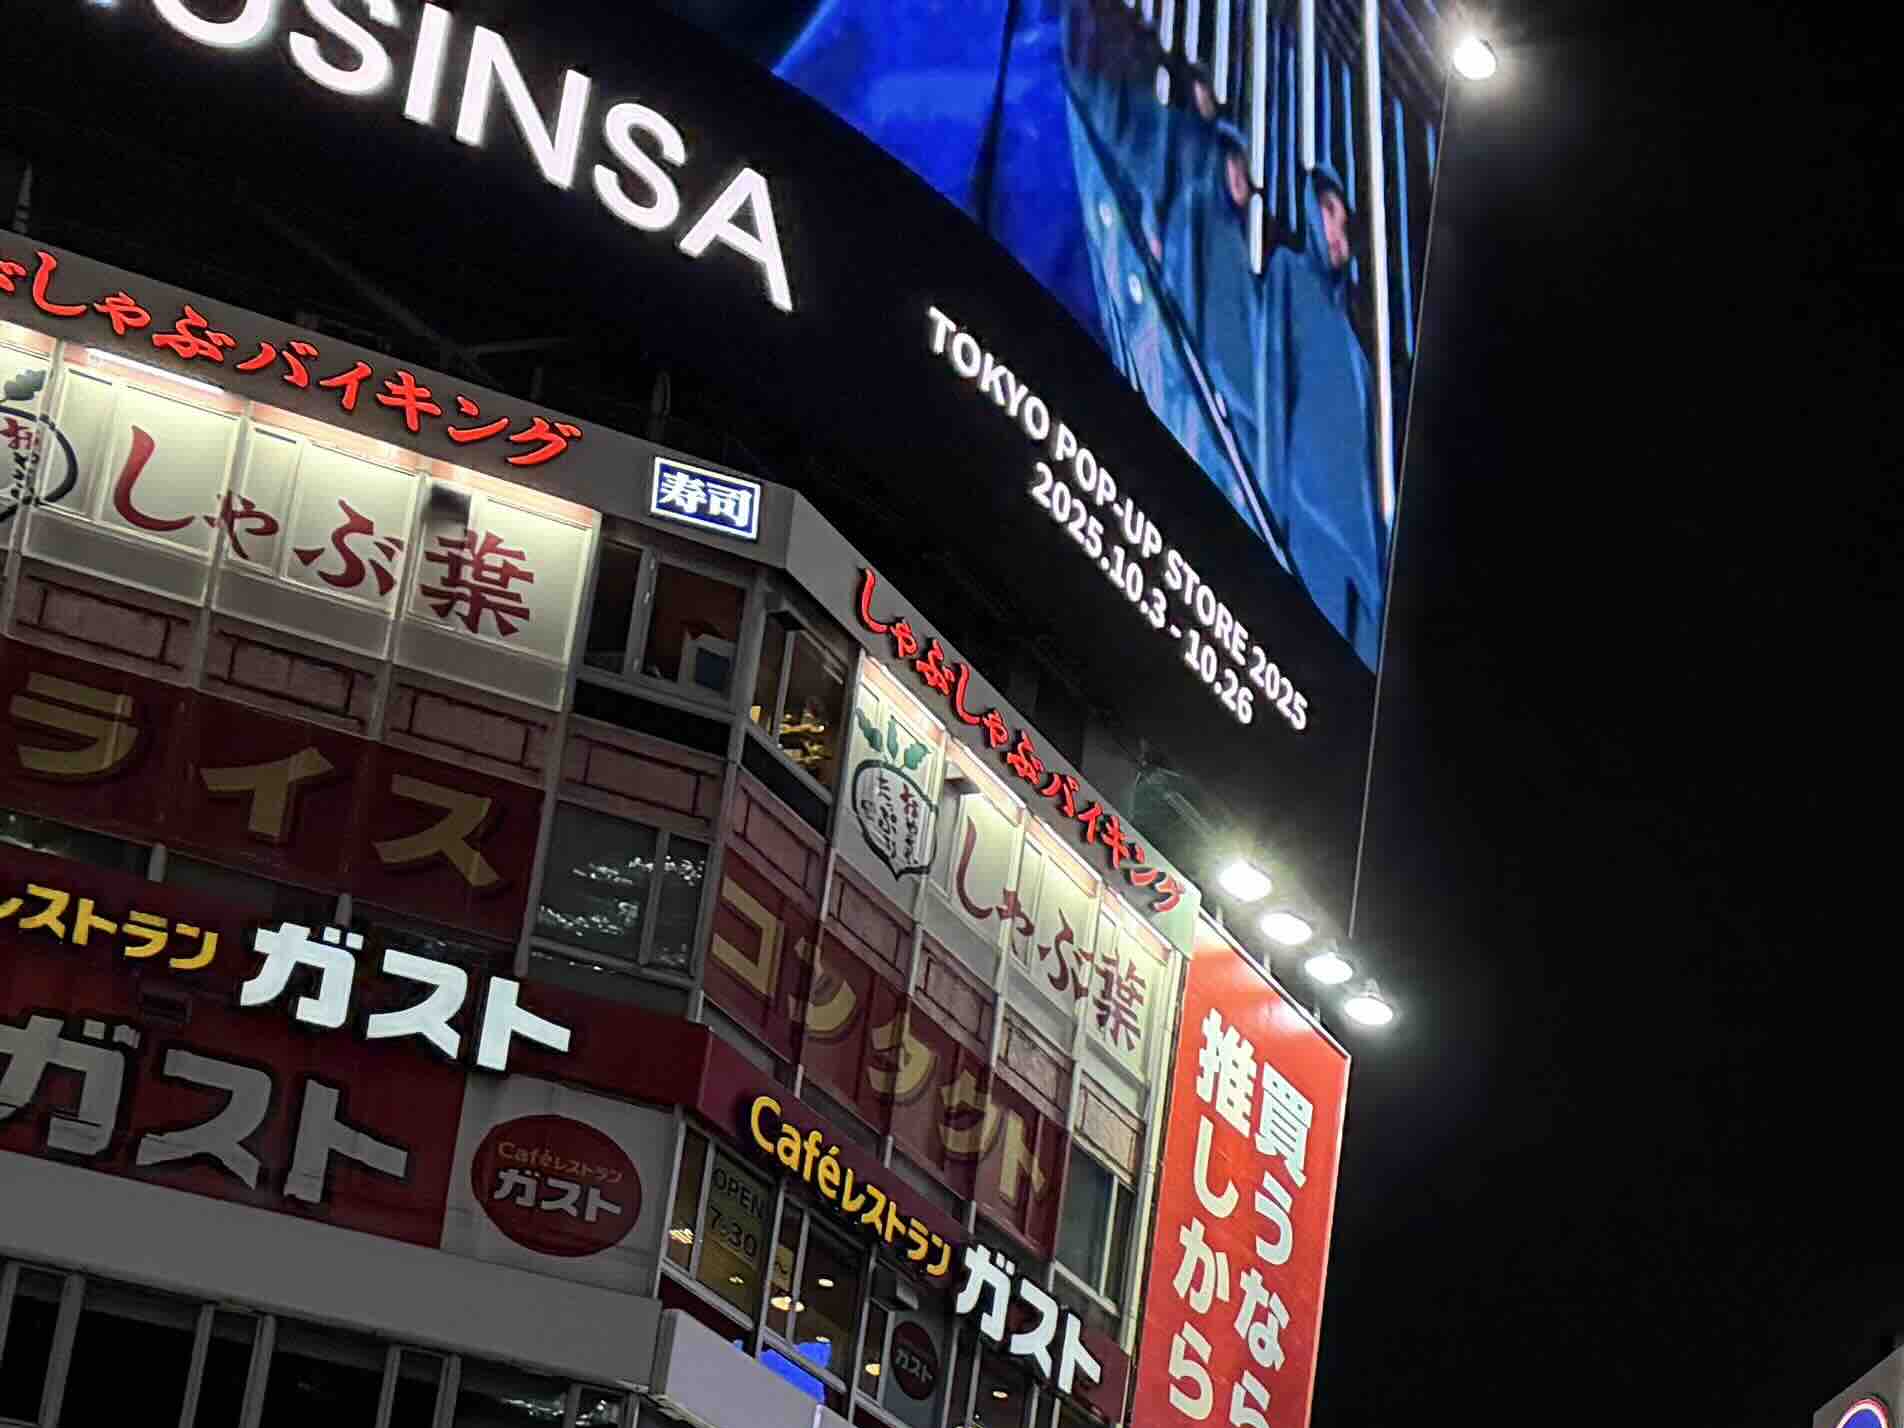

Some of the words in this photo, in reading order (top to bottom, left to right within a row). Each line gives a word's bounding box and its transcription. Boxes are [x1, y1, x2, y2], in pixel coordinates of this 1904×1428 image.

[112, 425, 535, 638] しゃぶ葉
[659, 471, 756, 529] 寿司
[927, 305, 1052, 442] TOKYO
[1054, 421, 1164, 560] POP-UP
[1164, 548, 1250, 667] STORE
[1248, 643, 1310, 731] 2025
[1029, 460, 1168, 630] 2025.10.3
[1184, 630, 1255, 726] 10.26
[8, 670, 501, 888] ライス
[855, 567, 1184, 913] しゃぶしゃぶバイキング
[239, 921, 572, 1073] ガスト
[951, 815, 1149, 1053] しゃぶ葉
[0, 1014, 409, 1204] ガスト
[494, 1169, 623, 1223] ガスト
[712, 1167, 766, 1221] OPEN
[750, 1095, 951, 1276] Caféレストラン
[956, 1244, 1101, 1394] ガスト
